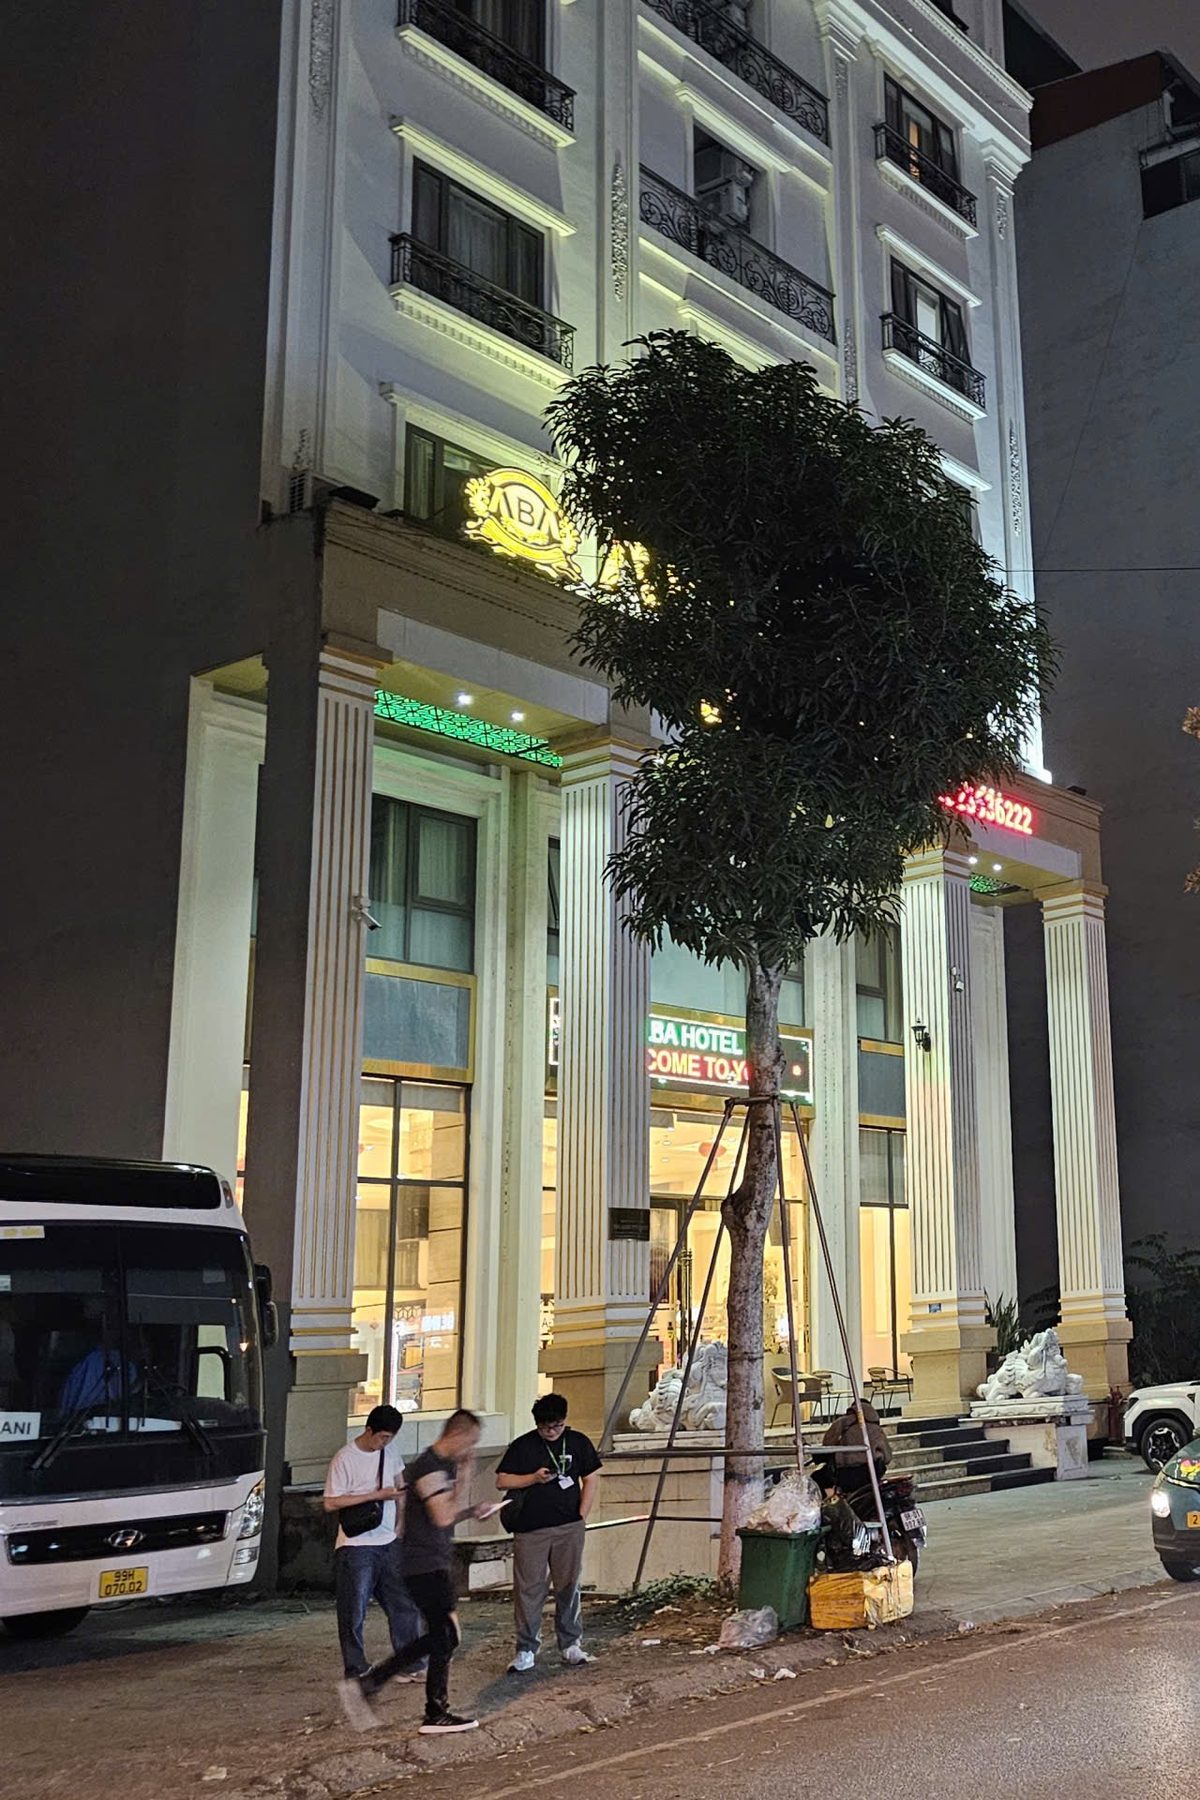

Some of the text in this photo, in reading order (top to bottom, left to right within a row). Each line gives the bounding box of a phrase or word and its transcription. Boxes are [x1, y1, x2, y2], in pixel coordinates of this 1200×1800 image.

[648, 1020, 743, 1056] BA HOTEL
[703, 1056, 729, 1080] TO
[114, 1570, 135, 1582] 99H
[105, 1580, 142, 1595] 070.02
